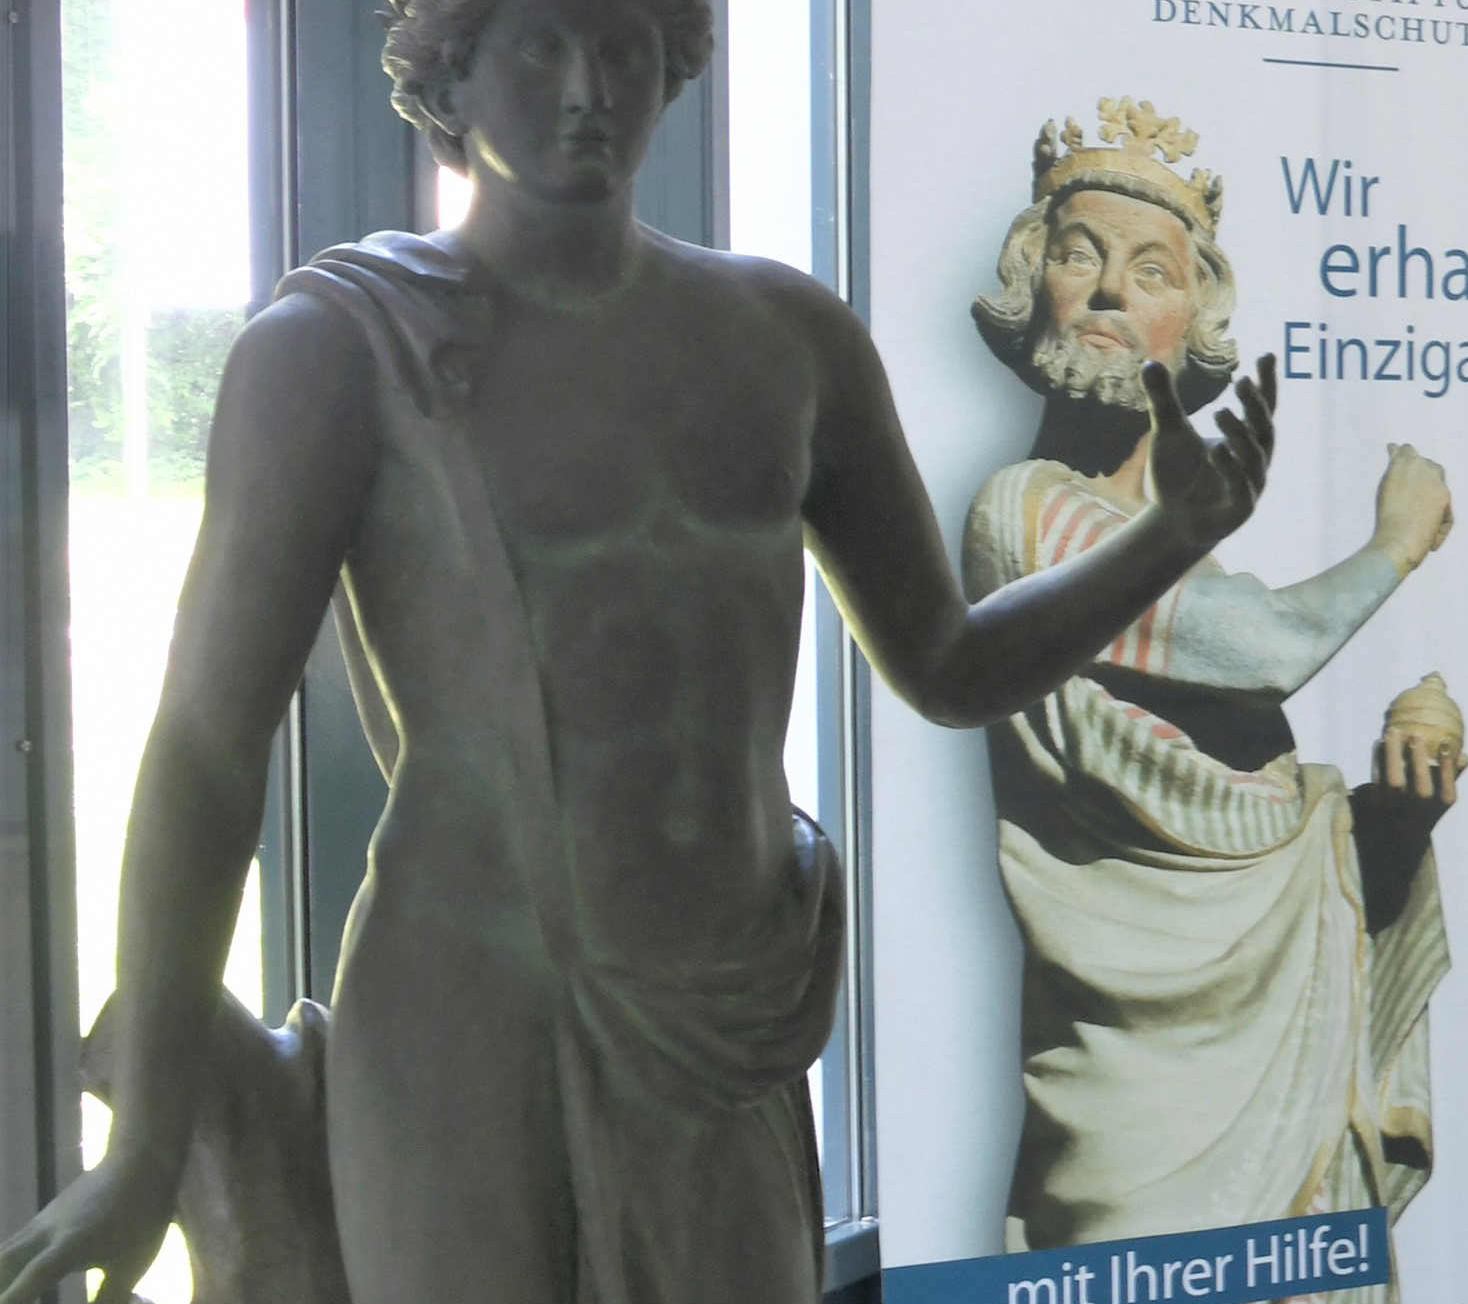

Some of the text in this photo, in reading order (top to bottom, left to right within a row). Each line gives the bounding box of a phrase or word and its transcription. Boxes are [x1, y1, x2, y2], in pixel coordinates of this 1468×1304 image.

[1280, 156, 1379, 217] Wir
[1111, 1251, 1233, 1304] Ihrer
[1246, 1223, 1370, 1287] Hilfe!
